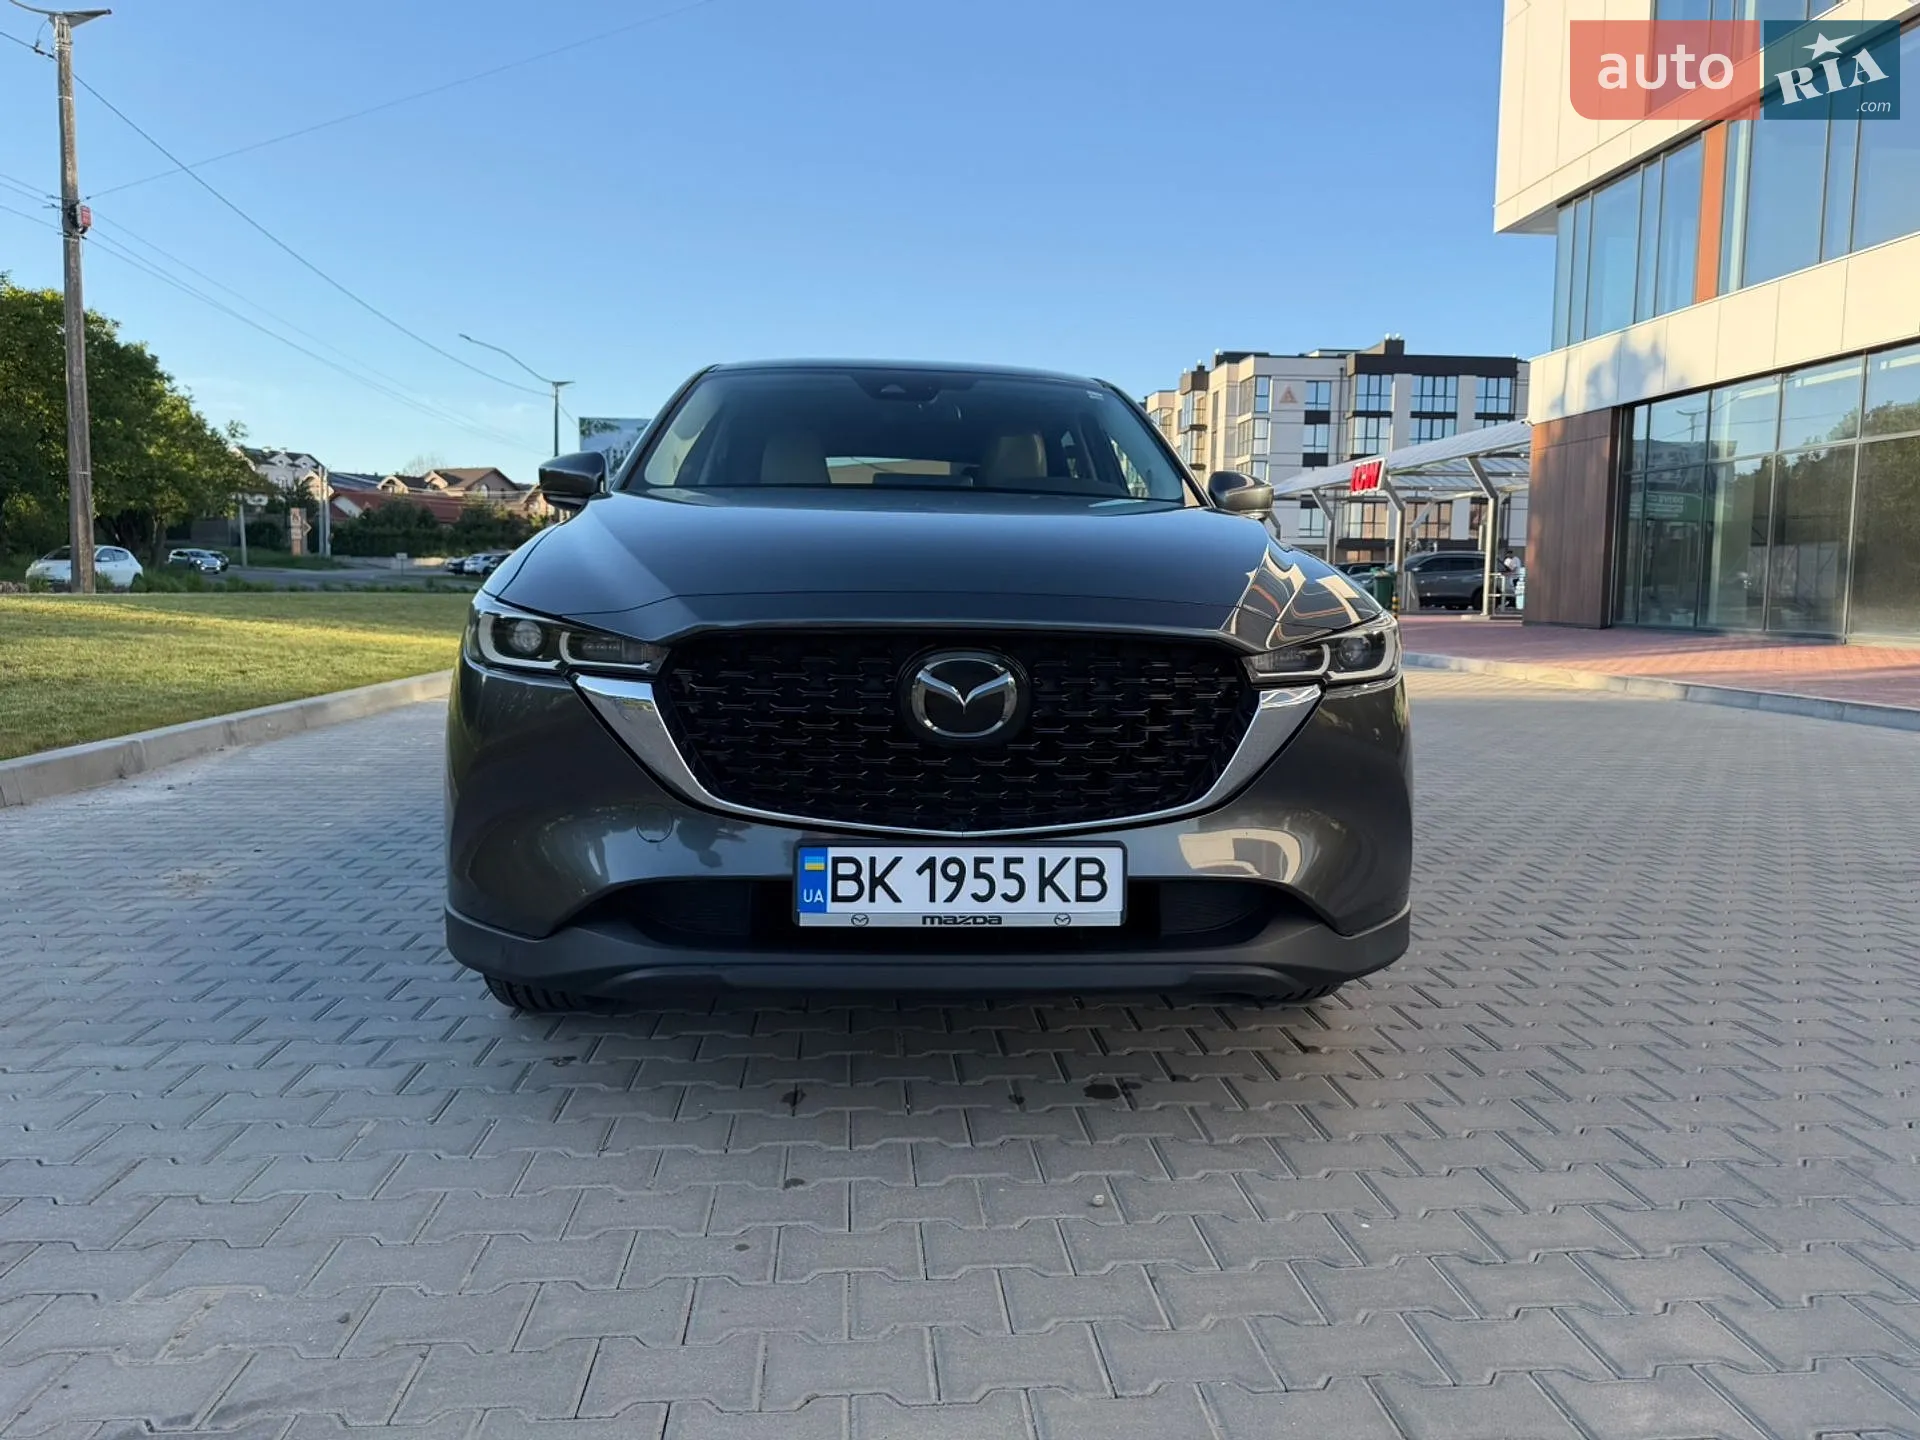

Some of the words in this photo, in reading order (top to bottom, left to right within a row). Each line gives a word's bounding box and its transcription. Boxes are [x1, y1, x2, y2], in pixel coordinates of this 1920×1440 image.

[831, 855, 903, 903] BK
[915, 855, 1027, 903] 1955
[1038, 855, 1108, 903] KB
[803, 888, 825, 903] UA
